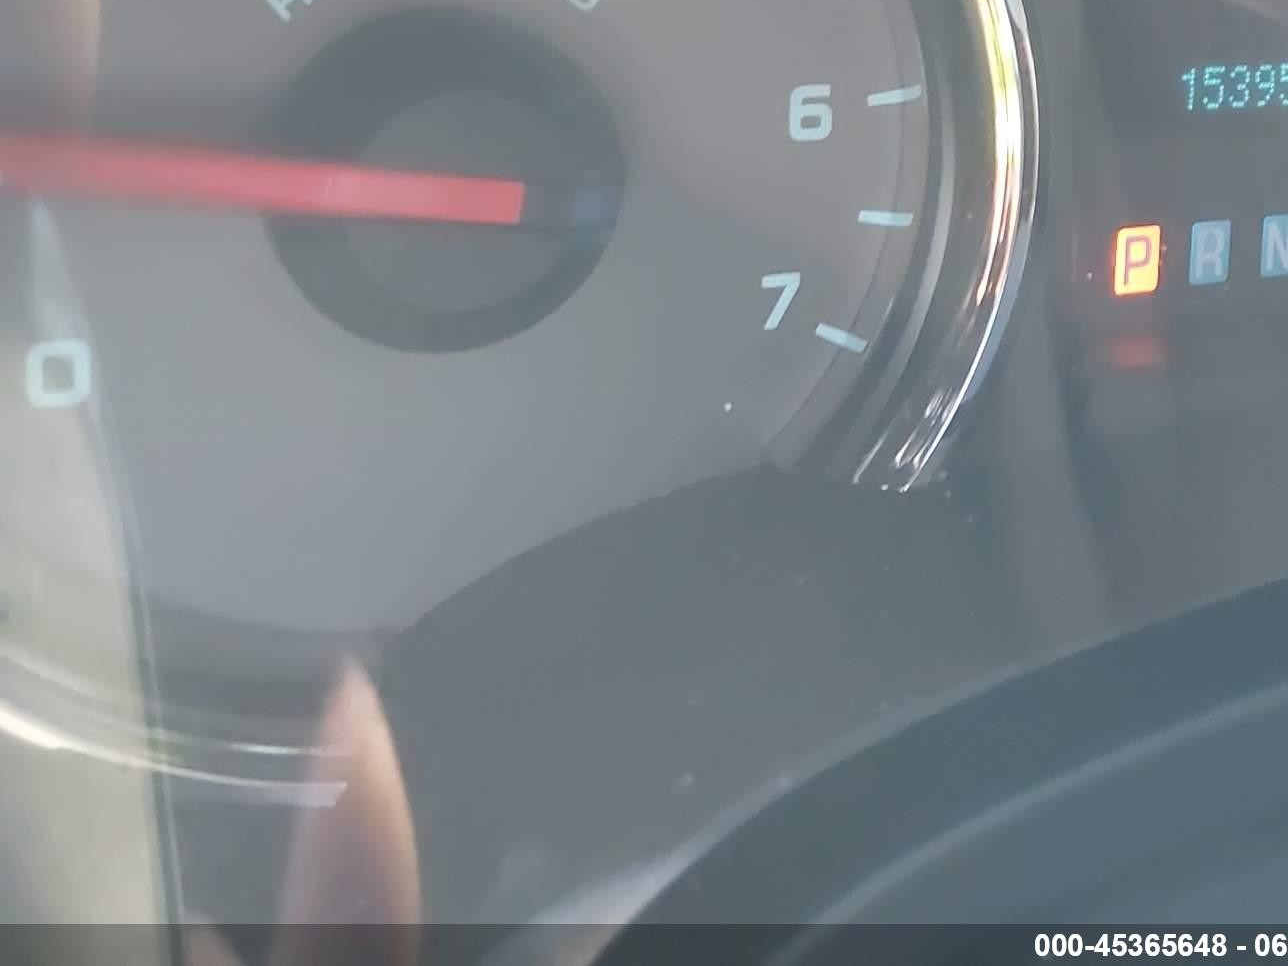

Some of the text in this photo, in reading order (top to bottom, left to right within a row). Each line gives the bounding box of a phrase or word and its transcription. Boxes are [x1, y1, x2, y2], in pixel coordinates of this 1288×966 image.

[788, 84, 833, 142] 6
[1123, 235, 1153, 285] P
[1195, 226, 1226, 279] R
[761, 272, 800, 331] 7
[24, 339, 92, 409] 0
